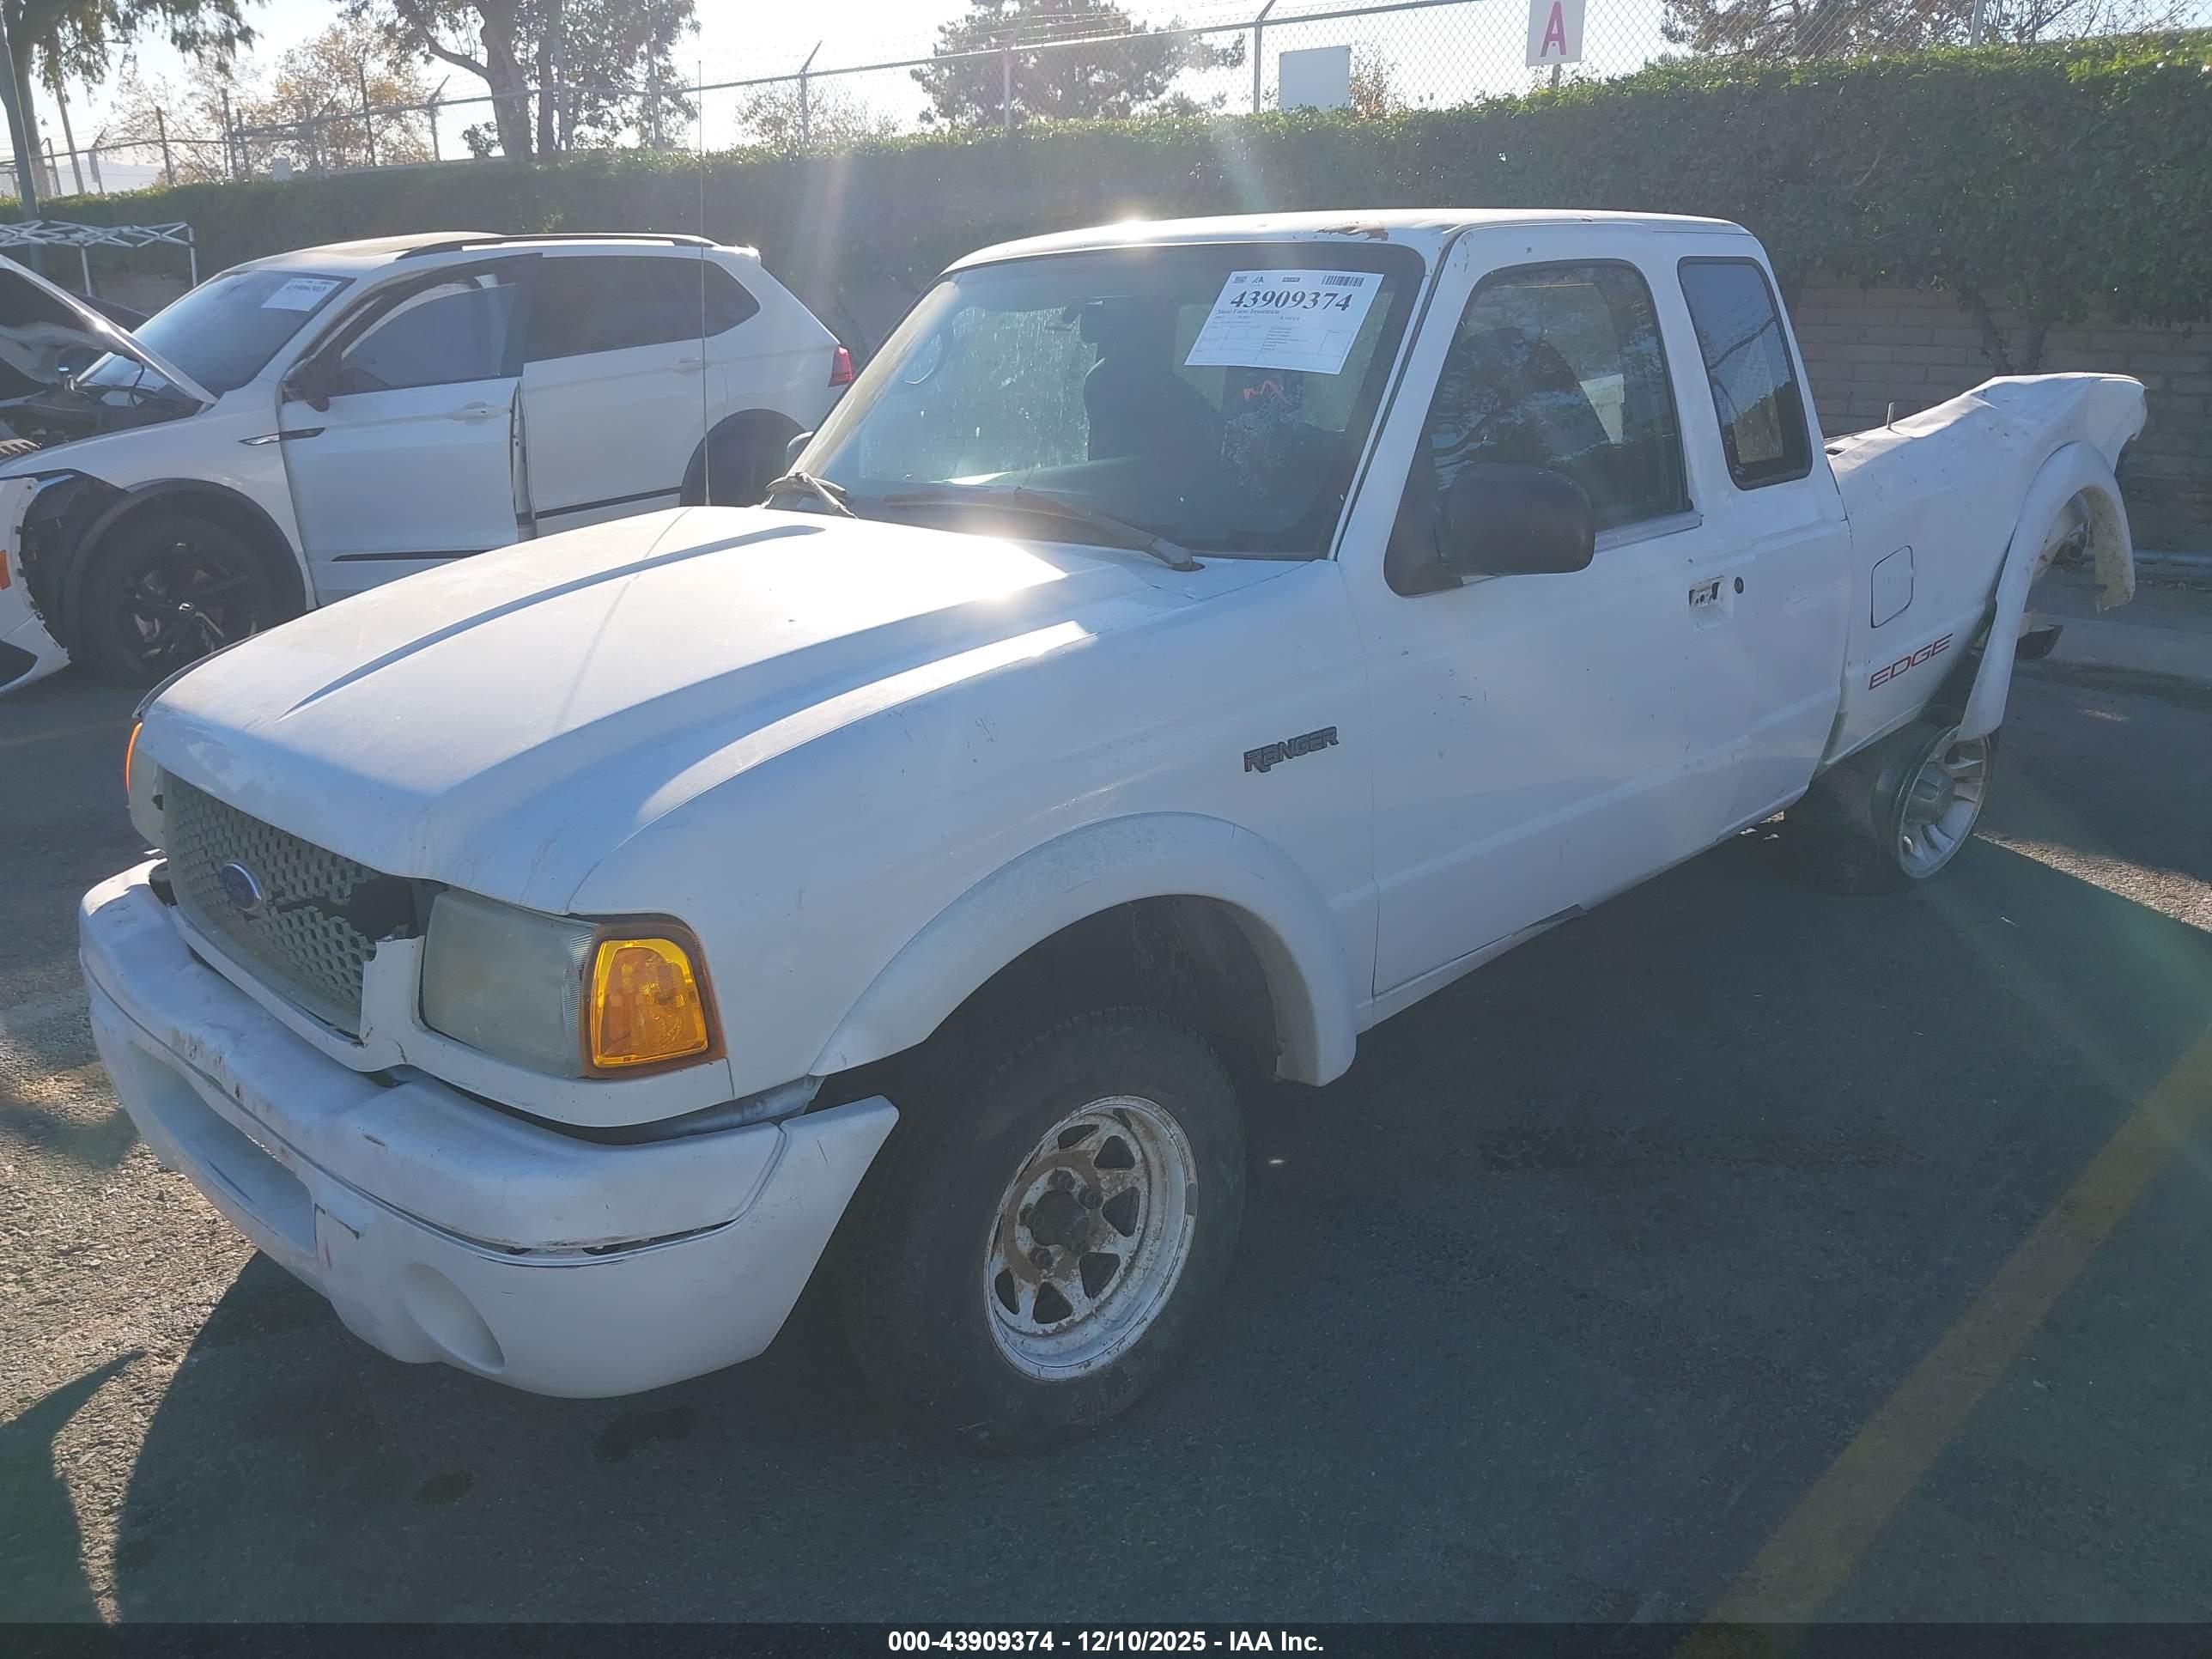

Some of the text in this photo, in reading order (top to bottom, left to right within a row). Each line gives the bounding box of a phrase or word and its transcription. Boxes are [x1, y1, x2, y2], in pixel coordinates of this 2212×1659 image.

[1540, 2, 1566, 58] A
[1230, 290, 1353, 312] 43909374
[1869, 632, 1954, 690] EDGE
[1243, 726, 1340, 773] RANGER
